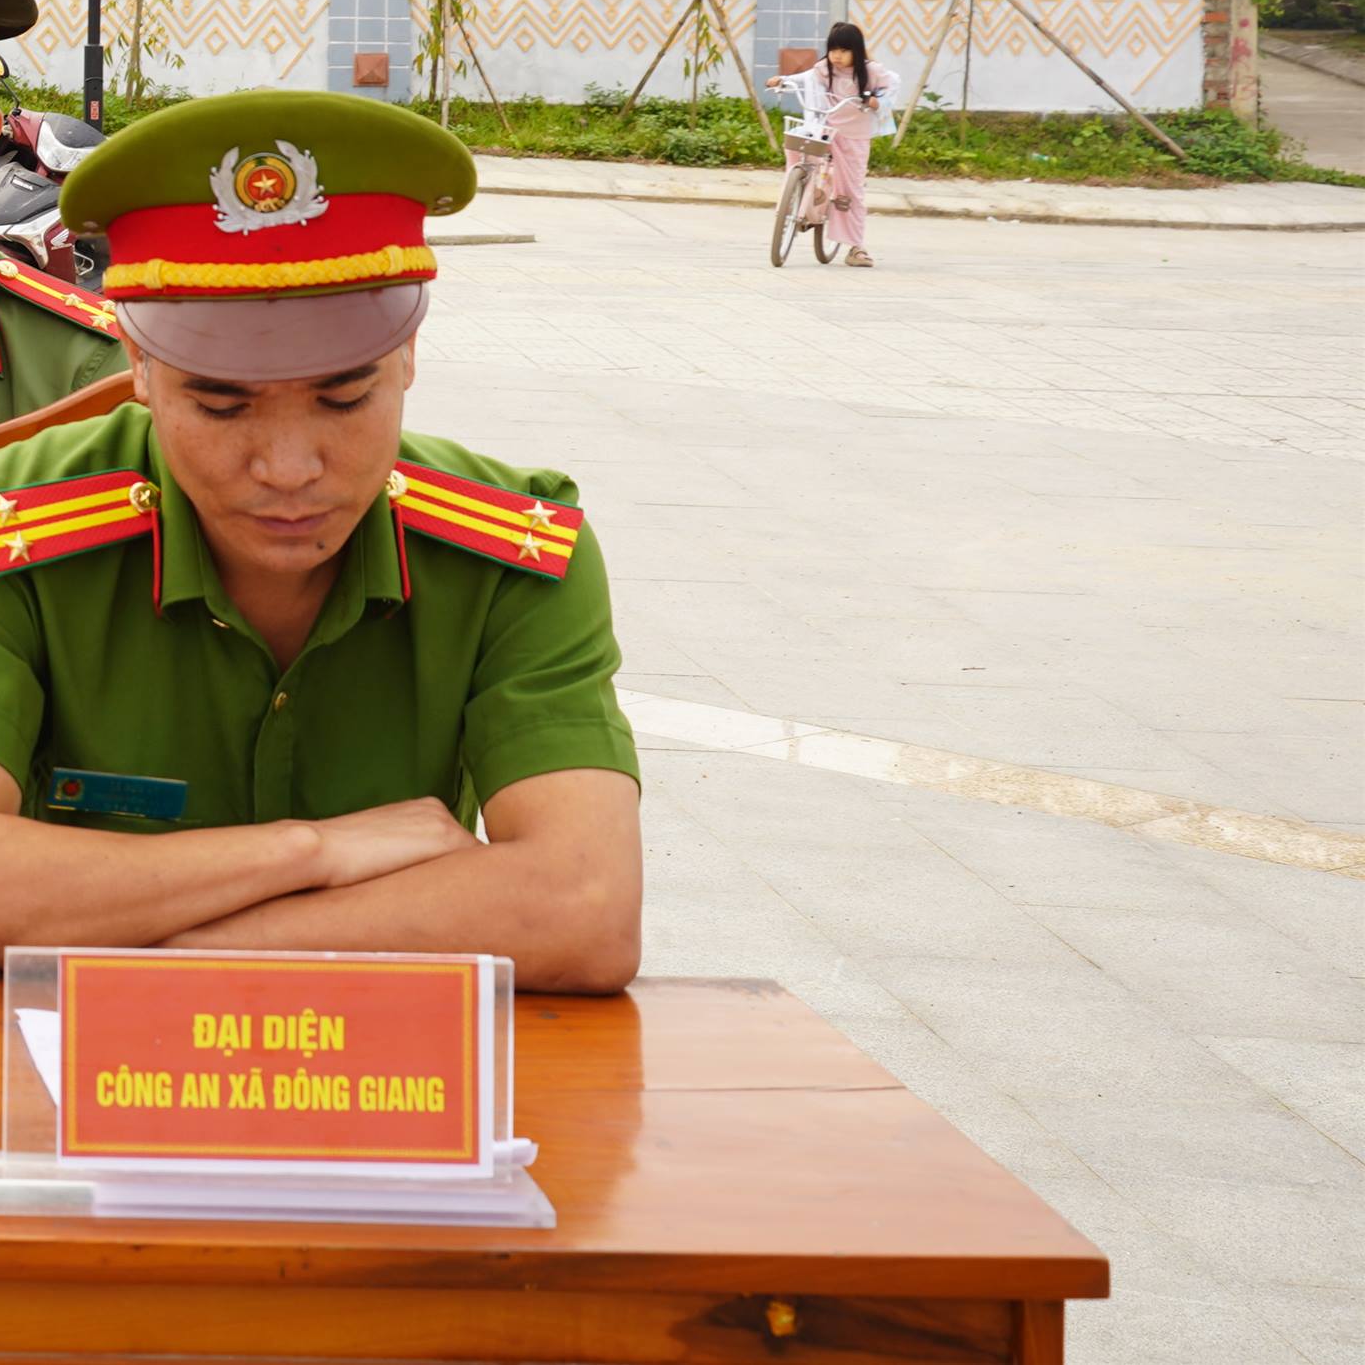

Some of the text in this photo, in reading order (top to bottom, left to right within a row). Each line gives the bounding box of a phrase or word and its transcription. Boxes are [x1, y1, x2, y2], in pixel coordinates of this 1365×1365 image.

[192, 1007, 345, 1059] ĐẠI DIỆN
[96, 1064, 446, 1113] CÔNG AN XÃ ĐÔNG GIANG
